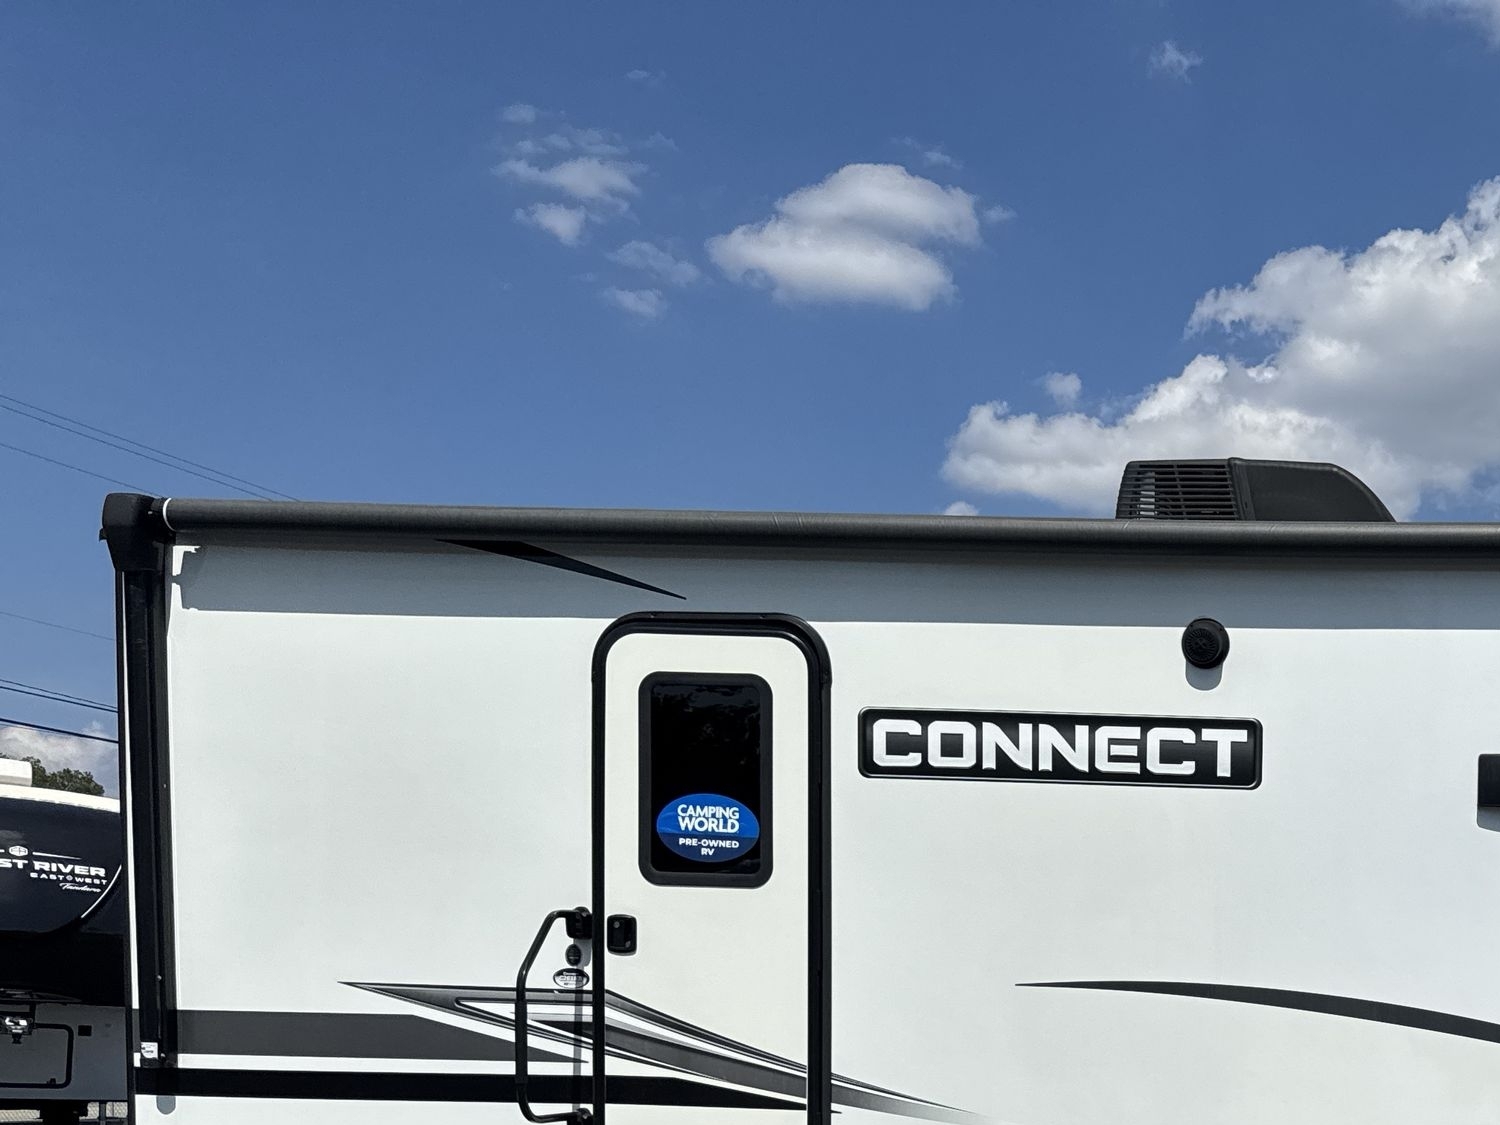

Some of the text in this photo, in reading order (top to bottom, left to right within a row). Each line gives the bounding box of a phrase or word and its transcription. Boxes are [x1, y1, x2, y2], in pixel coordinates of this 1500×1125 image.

[871, 718, 1249, 777] CONNECT
[677, 804, 740, 819] CAMPING
[678, 816, 740, 833] WORLD
[679, 837, 740, 848] PRE-OWNED
[701, 848, 715, 856] RV
[33, 860, 106, 877] RIVER
[30, 872, 108, 885] EAST WEST
